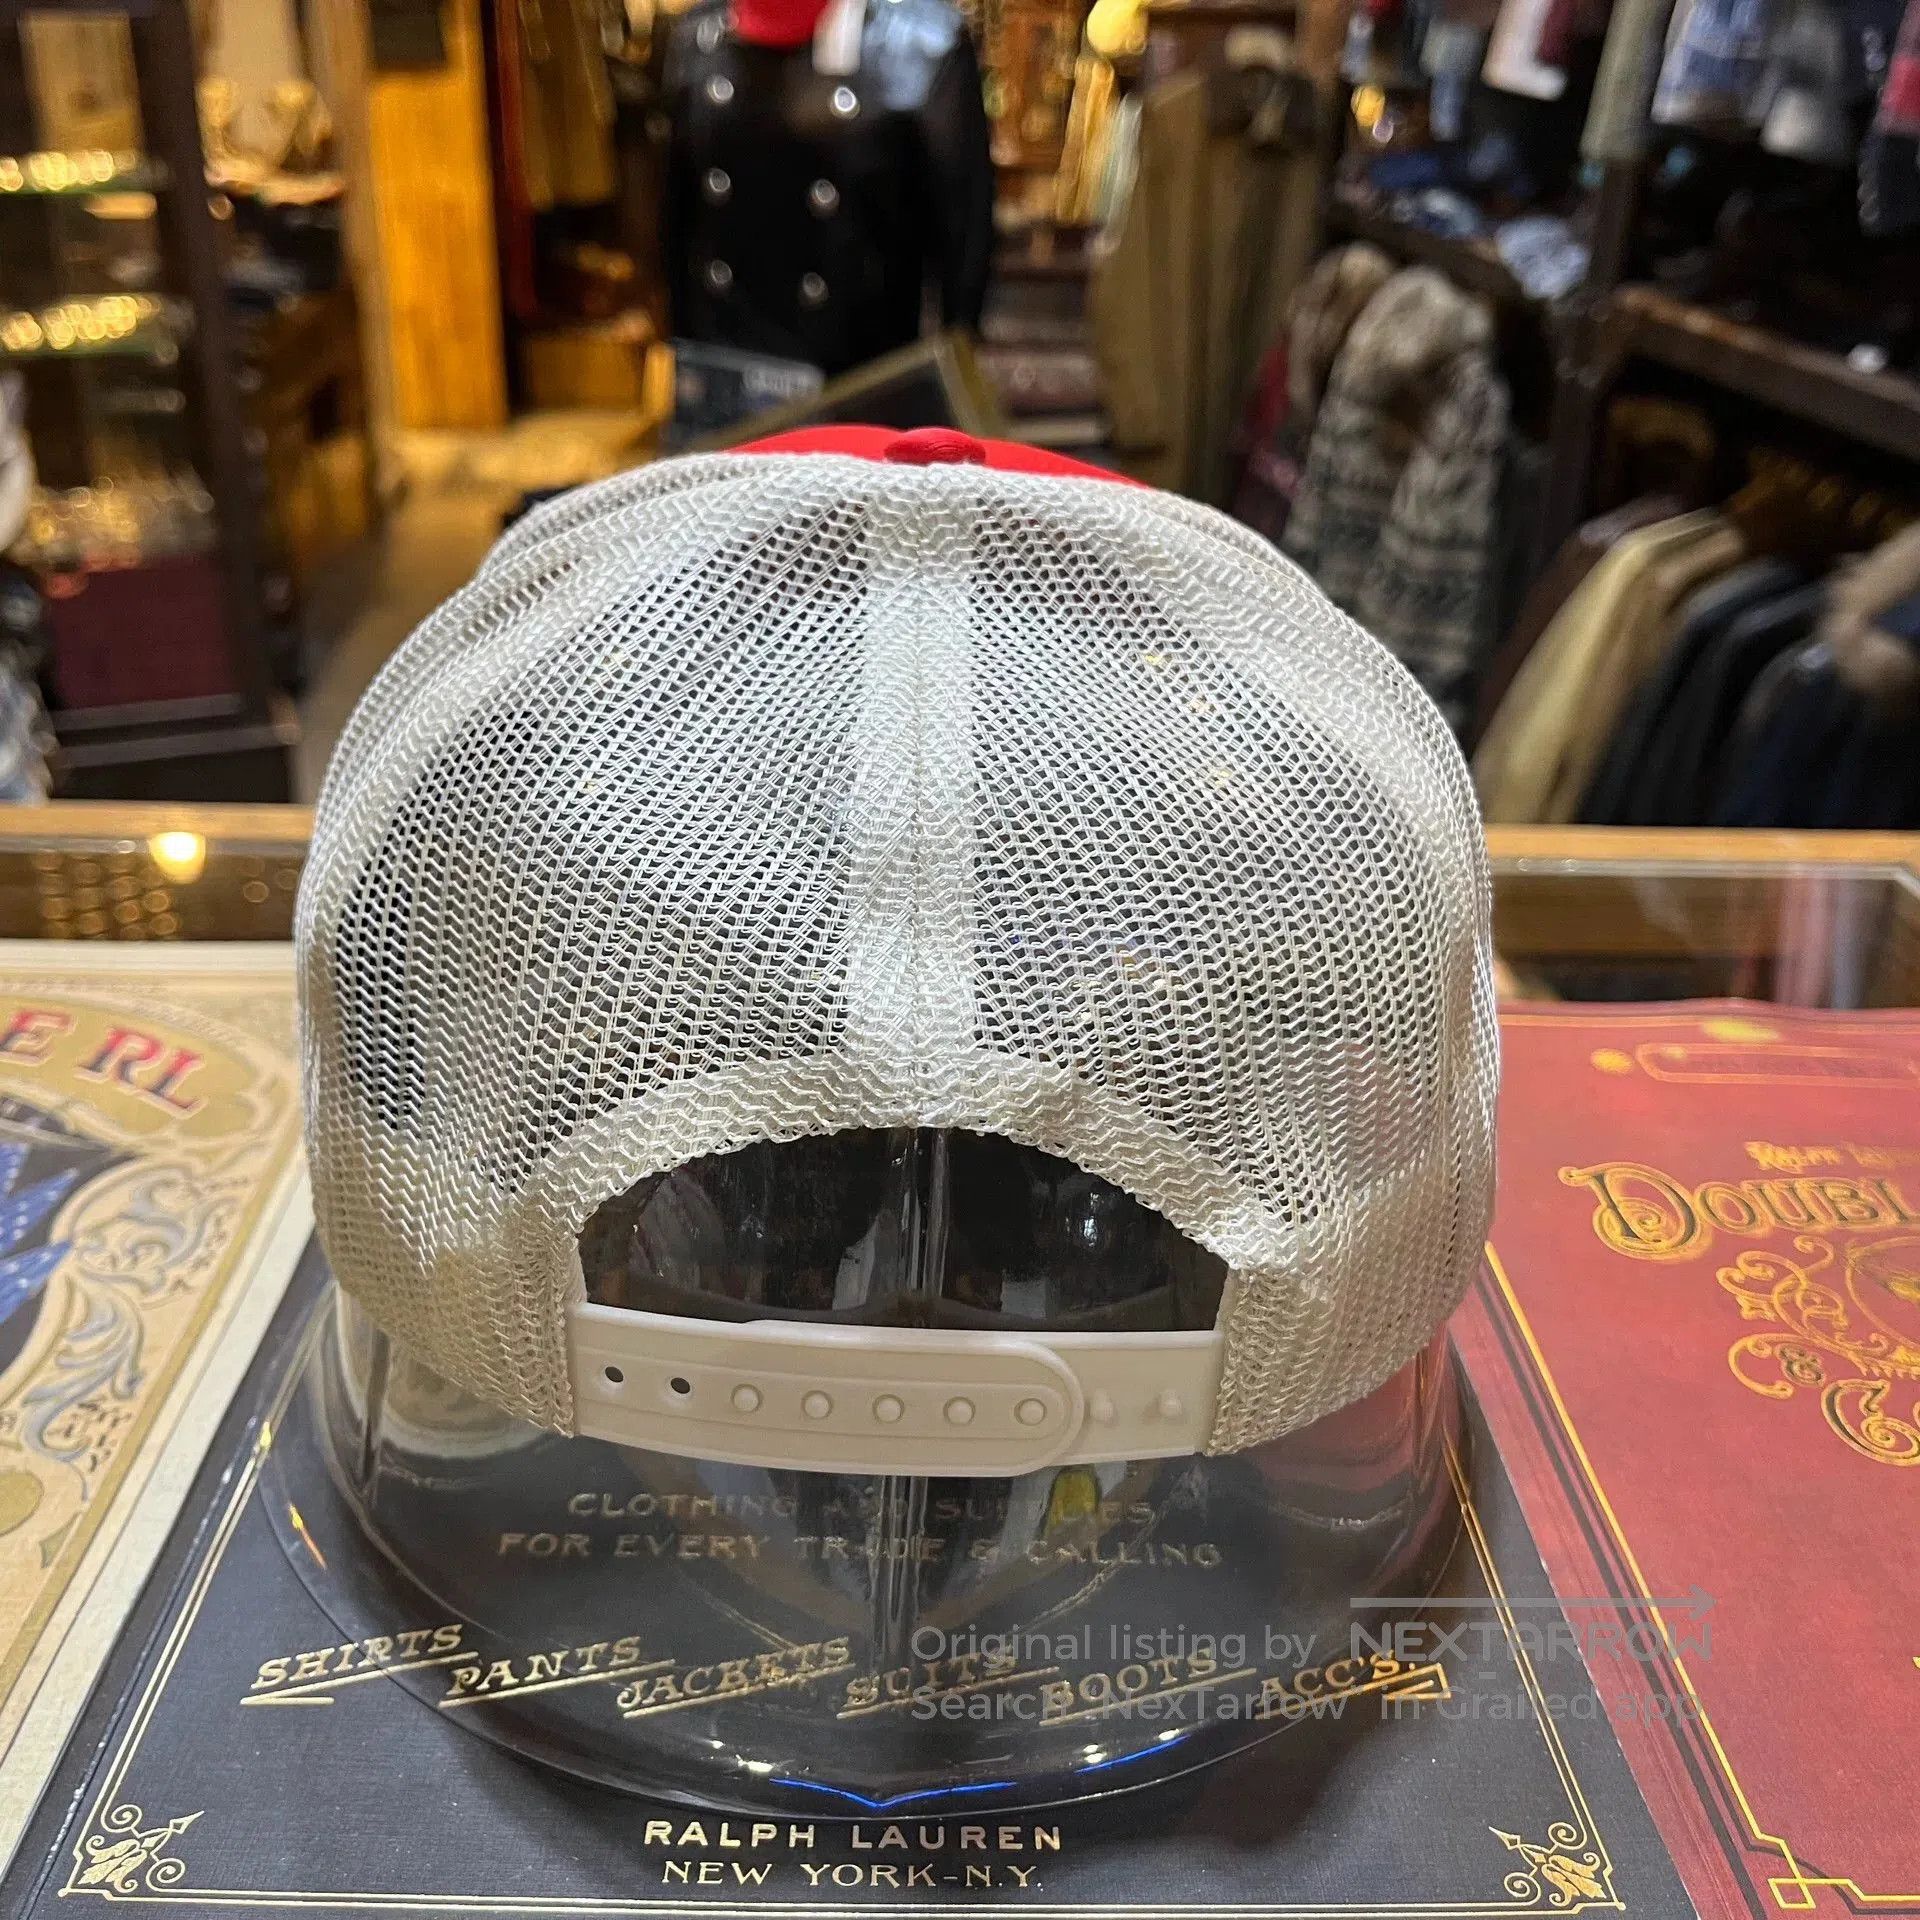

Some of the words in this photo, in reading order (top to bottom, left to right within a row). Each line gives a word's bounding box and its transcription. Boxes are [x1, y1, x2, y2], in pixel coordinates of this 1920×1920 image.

[74, 1025, 208, 1120] RL
[568, 1492, 798, 1518] CLOTHING
[499, 1532, 592, 1558] FOR
[613, 1533, 770, 1560] EVERY
[250, 1623, 463, 1689] SHIRTS
[446, 1635, 641, 1696] PANTS
[616, 1635, 850, 1710] JACKETS
[842, 1643, 1018, 1713] SUITS
[1039, 1646, 1217, 1712] BOOTS
[644, 1820, 815, 1848] RALPH
[851, 1824, 1061, 1850] LAUREN
[661, 1860, 773, 1885] NEW
